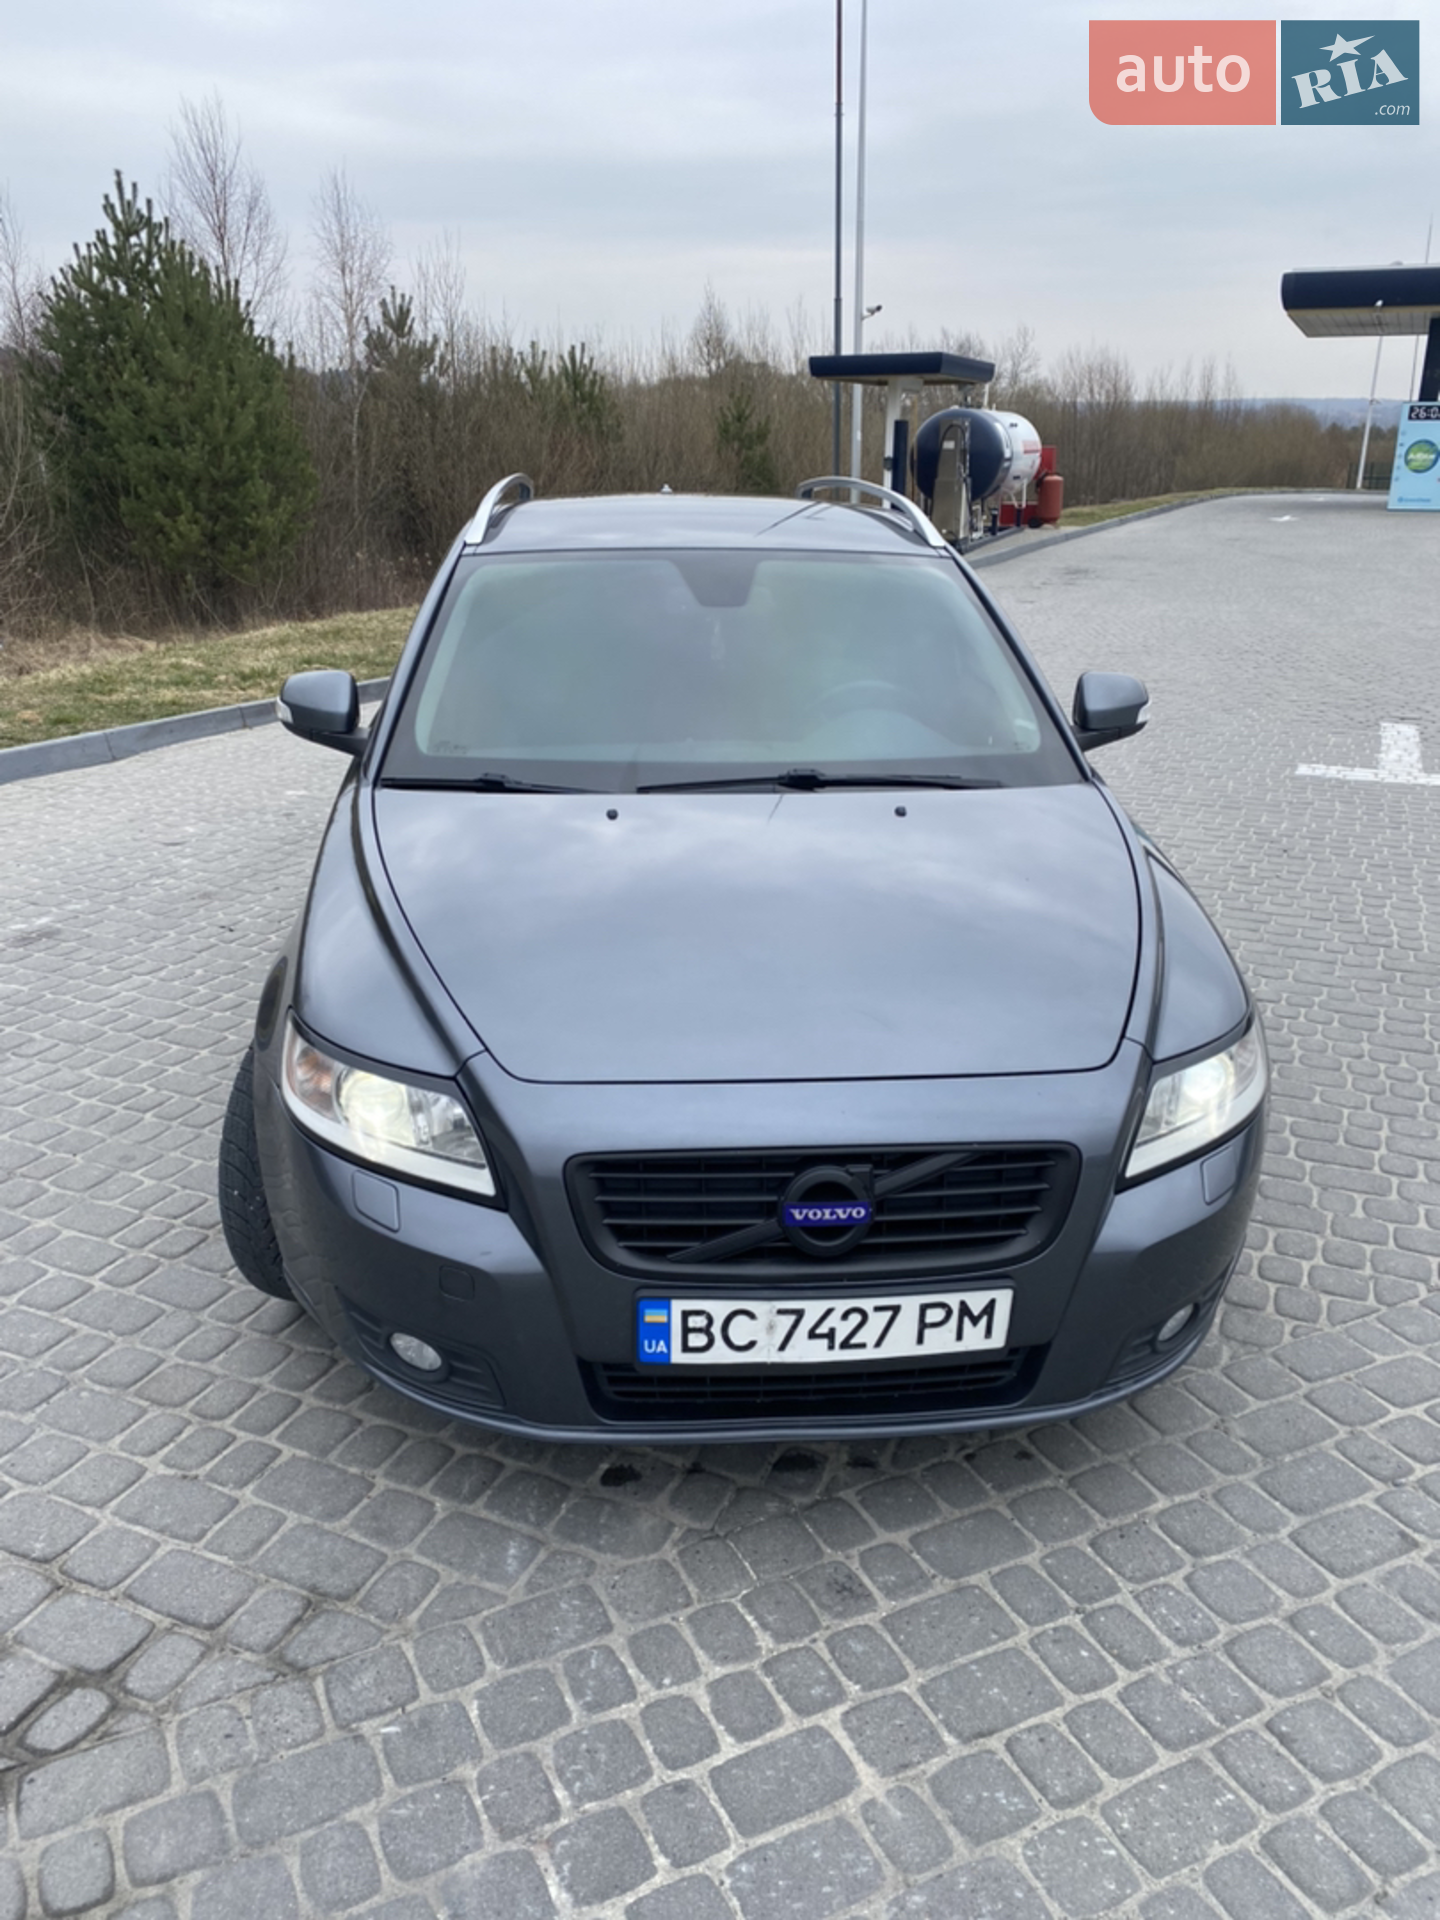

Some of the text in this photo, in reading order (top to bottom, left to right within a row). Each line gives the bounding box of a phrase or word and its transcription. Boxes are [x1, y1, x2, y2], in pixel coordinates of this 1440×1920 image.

[788, 1207, 866, 1221] VOLVO
[680, 1297, 997, 1354] BC 7427 PM
[643, 1340, 668, 1354] UA
